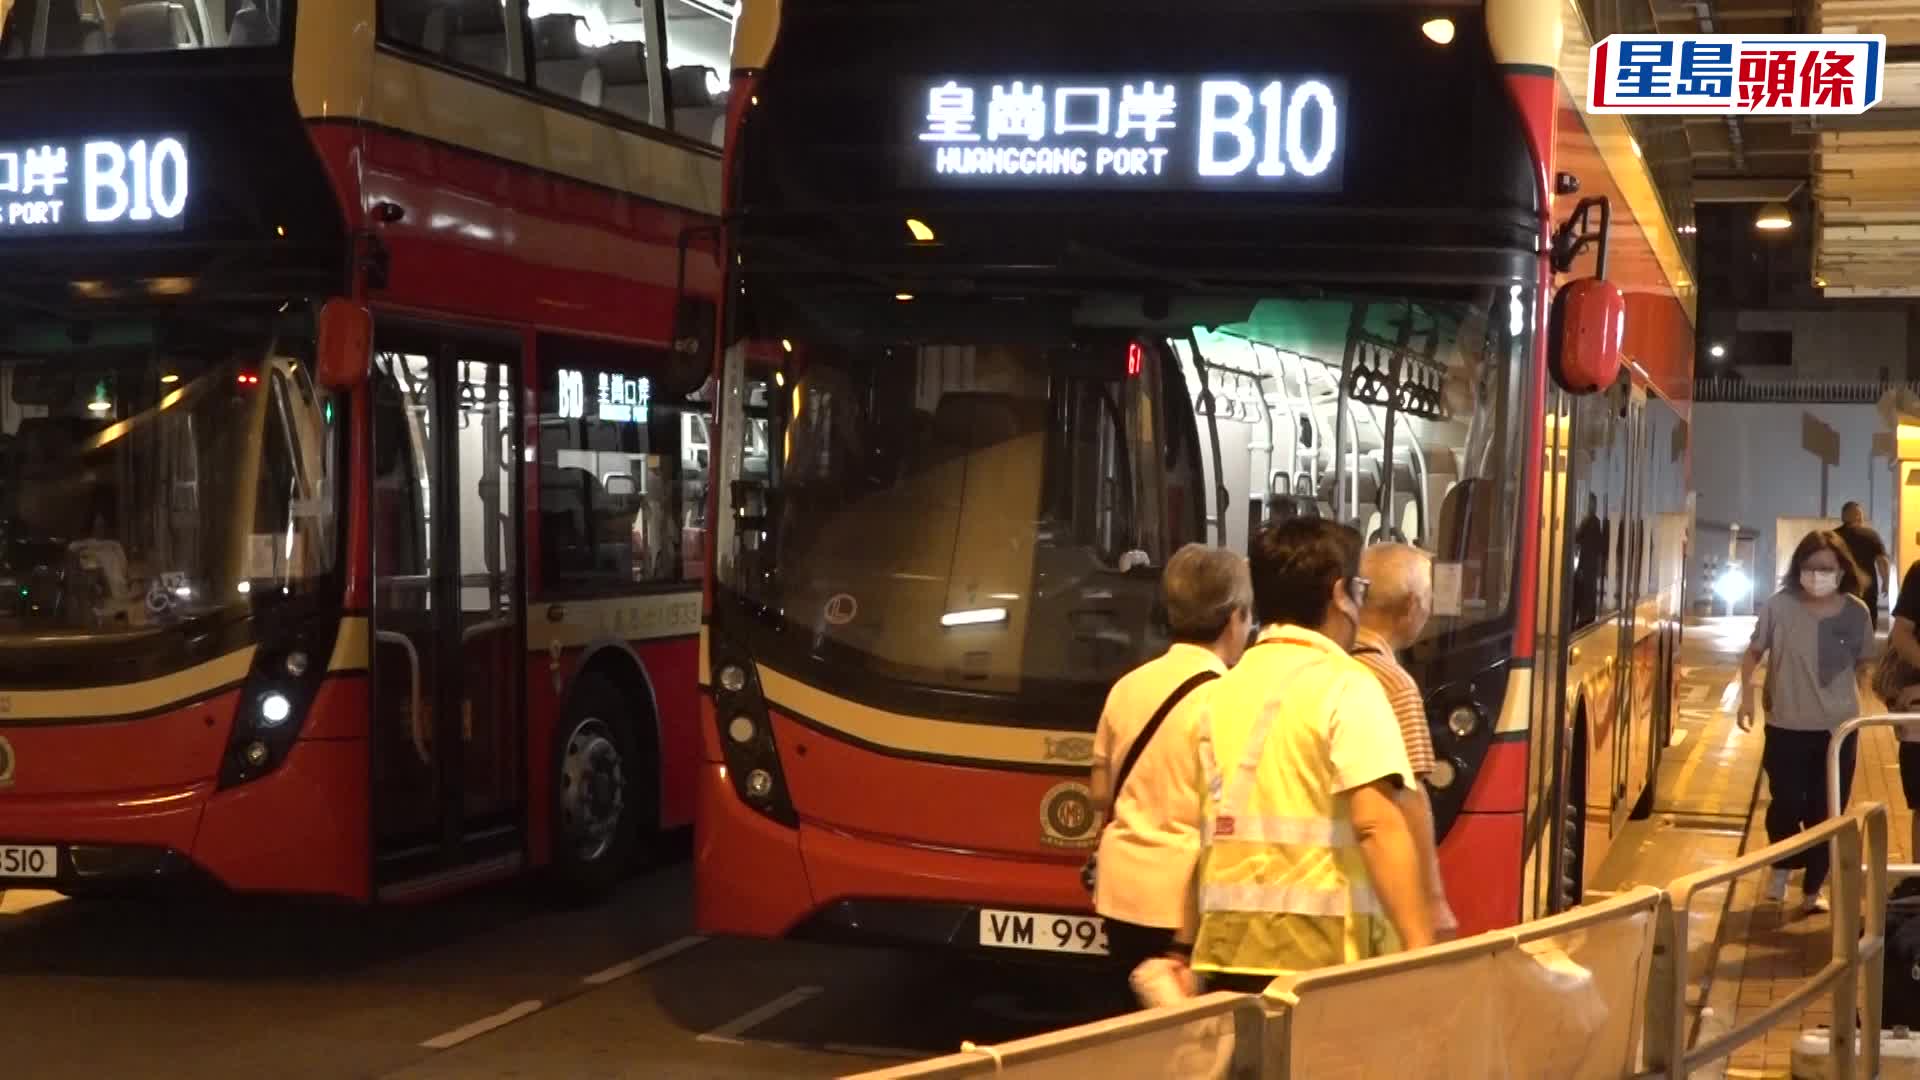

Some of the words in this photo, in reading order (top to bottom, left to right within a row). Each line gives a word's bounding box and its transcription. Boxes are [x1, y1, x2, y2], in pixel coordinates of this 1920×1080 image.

[919, 81, 1177, 142] 皇崗口岸
[1198, 81, 1337, 176] B10
[84, 138, 188, 222] B10
[937, 147, 1087, 175] HUANGGANG
[1097, 148, 1168, 175] PORT
[9, 200, 63, 224] PORT
[559, 369, 583, 418] B10
[0, 849, 44, 872] 510
[990, 913, 1034, 944] VM
